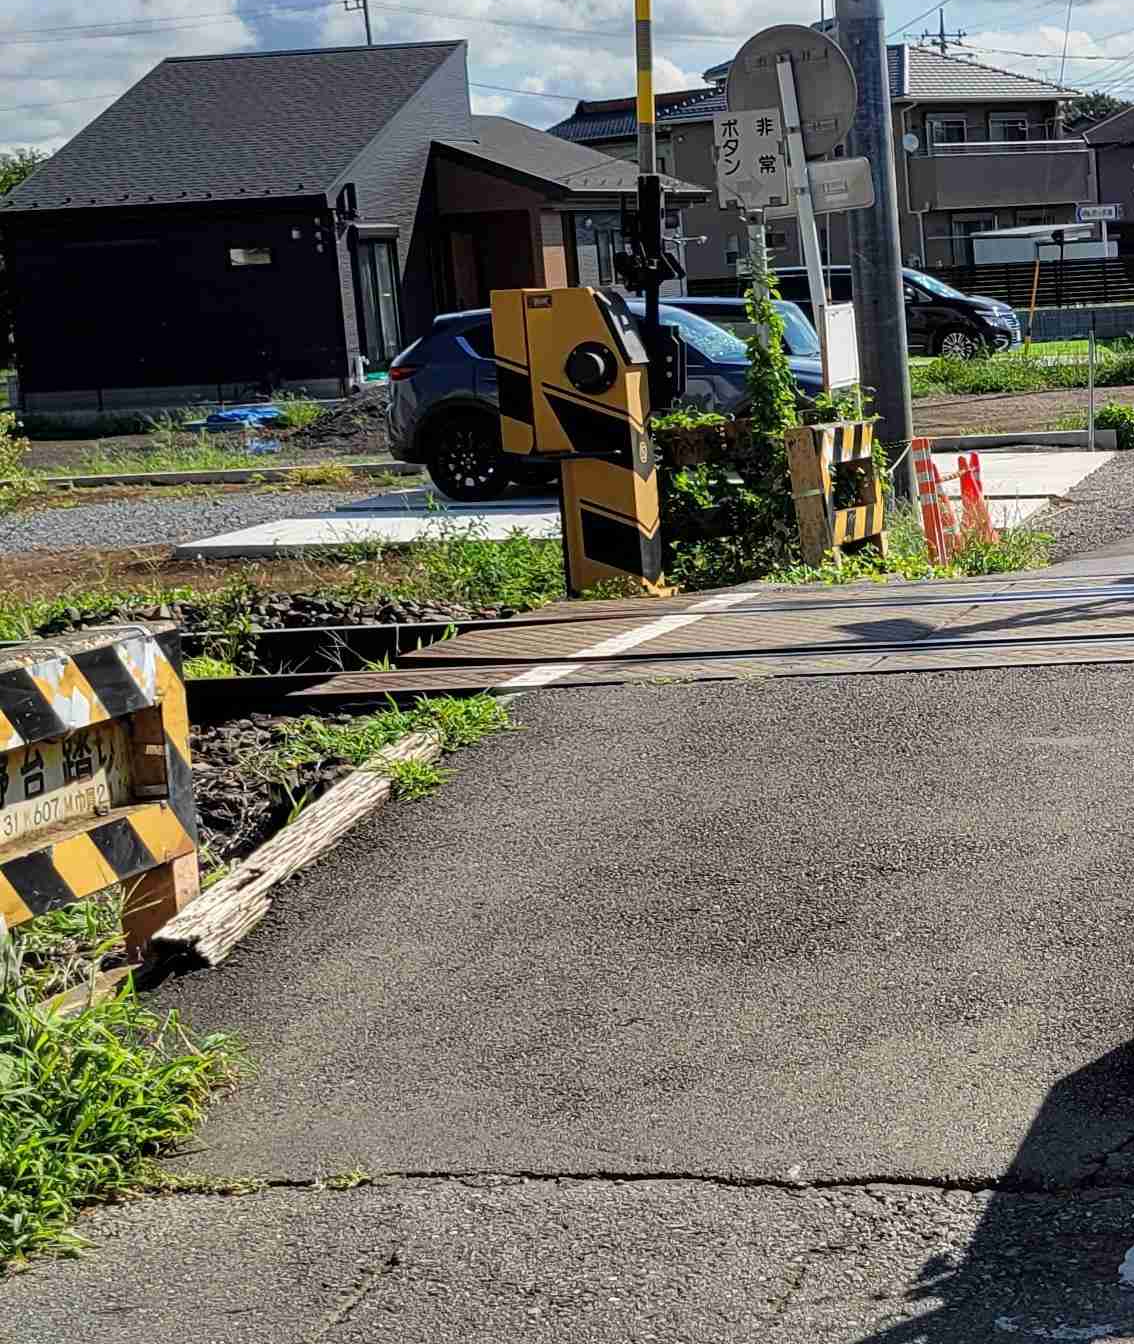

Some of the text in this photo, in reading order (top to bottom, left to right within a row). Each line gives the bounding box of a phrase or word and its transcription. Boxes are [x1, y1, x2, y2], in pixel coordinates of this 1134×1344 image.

[721, 119, 741, 176] ボタン
[756, 117, 776, 175] 非常
